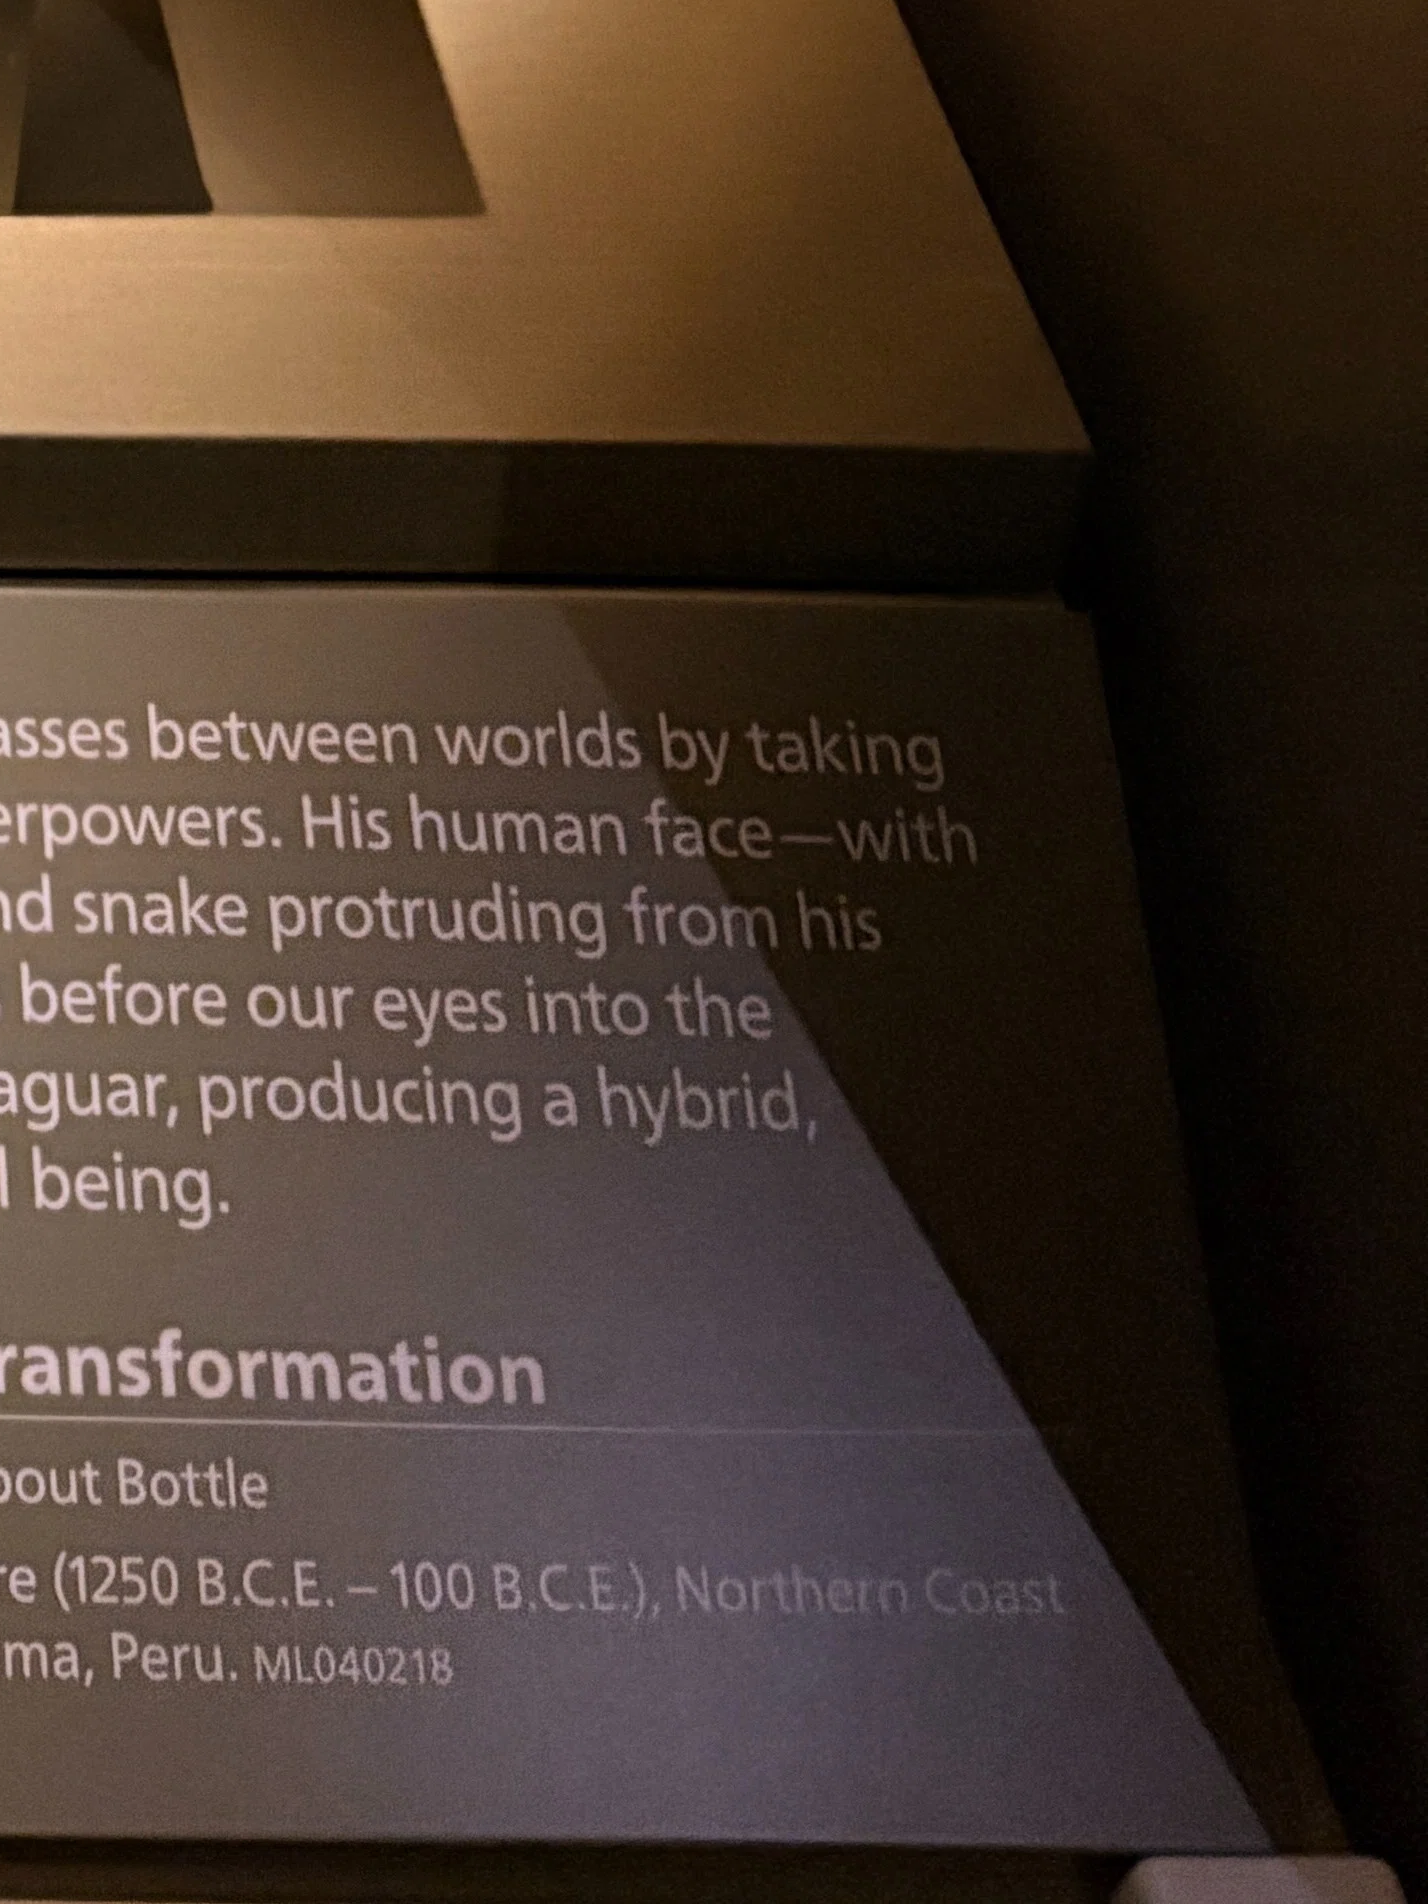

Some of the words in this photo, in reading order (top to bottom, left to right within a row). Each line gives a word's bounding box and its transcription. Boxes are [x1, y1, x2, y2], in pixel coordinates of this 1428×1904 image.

[146, 701, 419, 764] between
[434, 708, 642, 770] worlds
[657, 711, 730, 787] by
[744, 715, 946, 793] taking
[301, 794, 392, 852] His
[408, 792, 628, 856] human
[73, 875, 249, 938] snake
[268, 881, 608, 961] protruding
[623, 883, 778, 950] from
[795, 889, 884, 953] his
[19, 961, 228, 1028] before
[246, 983, 354, 1030] our
[372, 986, 508, 1048] eyes
[524, 975, 650, 1037] into
[665, 976, 774, 1042] the
[198, 1059, 523, 1144] producing
[543, 1082, 579, 1128] a
[596, 1064, 820, 1147] hybrid,
[31, 1145, 231, 1232] being.
[116, 1456, 269, 1510] Bottle
[53, 1551, 180, 1613] (1250
[196, 1557, 335, 1609] B.C.E.
[389, 1560, 476, 1612] 100
[491, 1561, 661, 1621] B.C.E.),
[674, 1563, 909, 1615] Northern
[924, 1567, 1066, 1617] Coast
[110, 1630, 239, 1683] Peru.
[253, 1644, 455, 1687] ML040218
